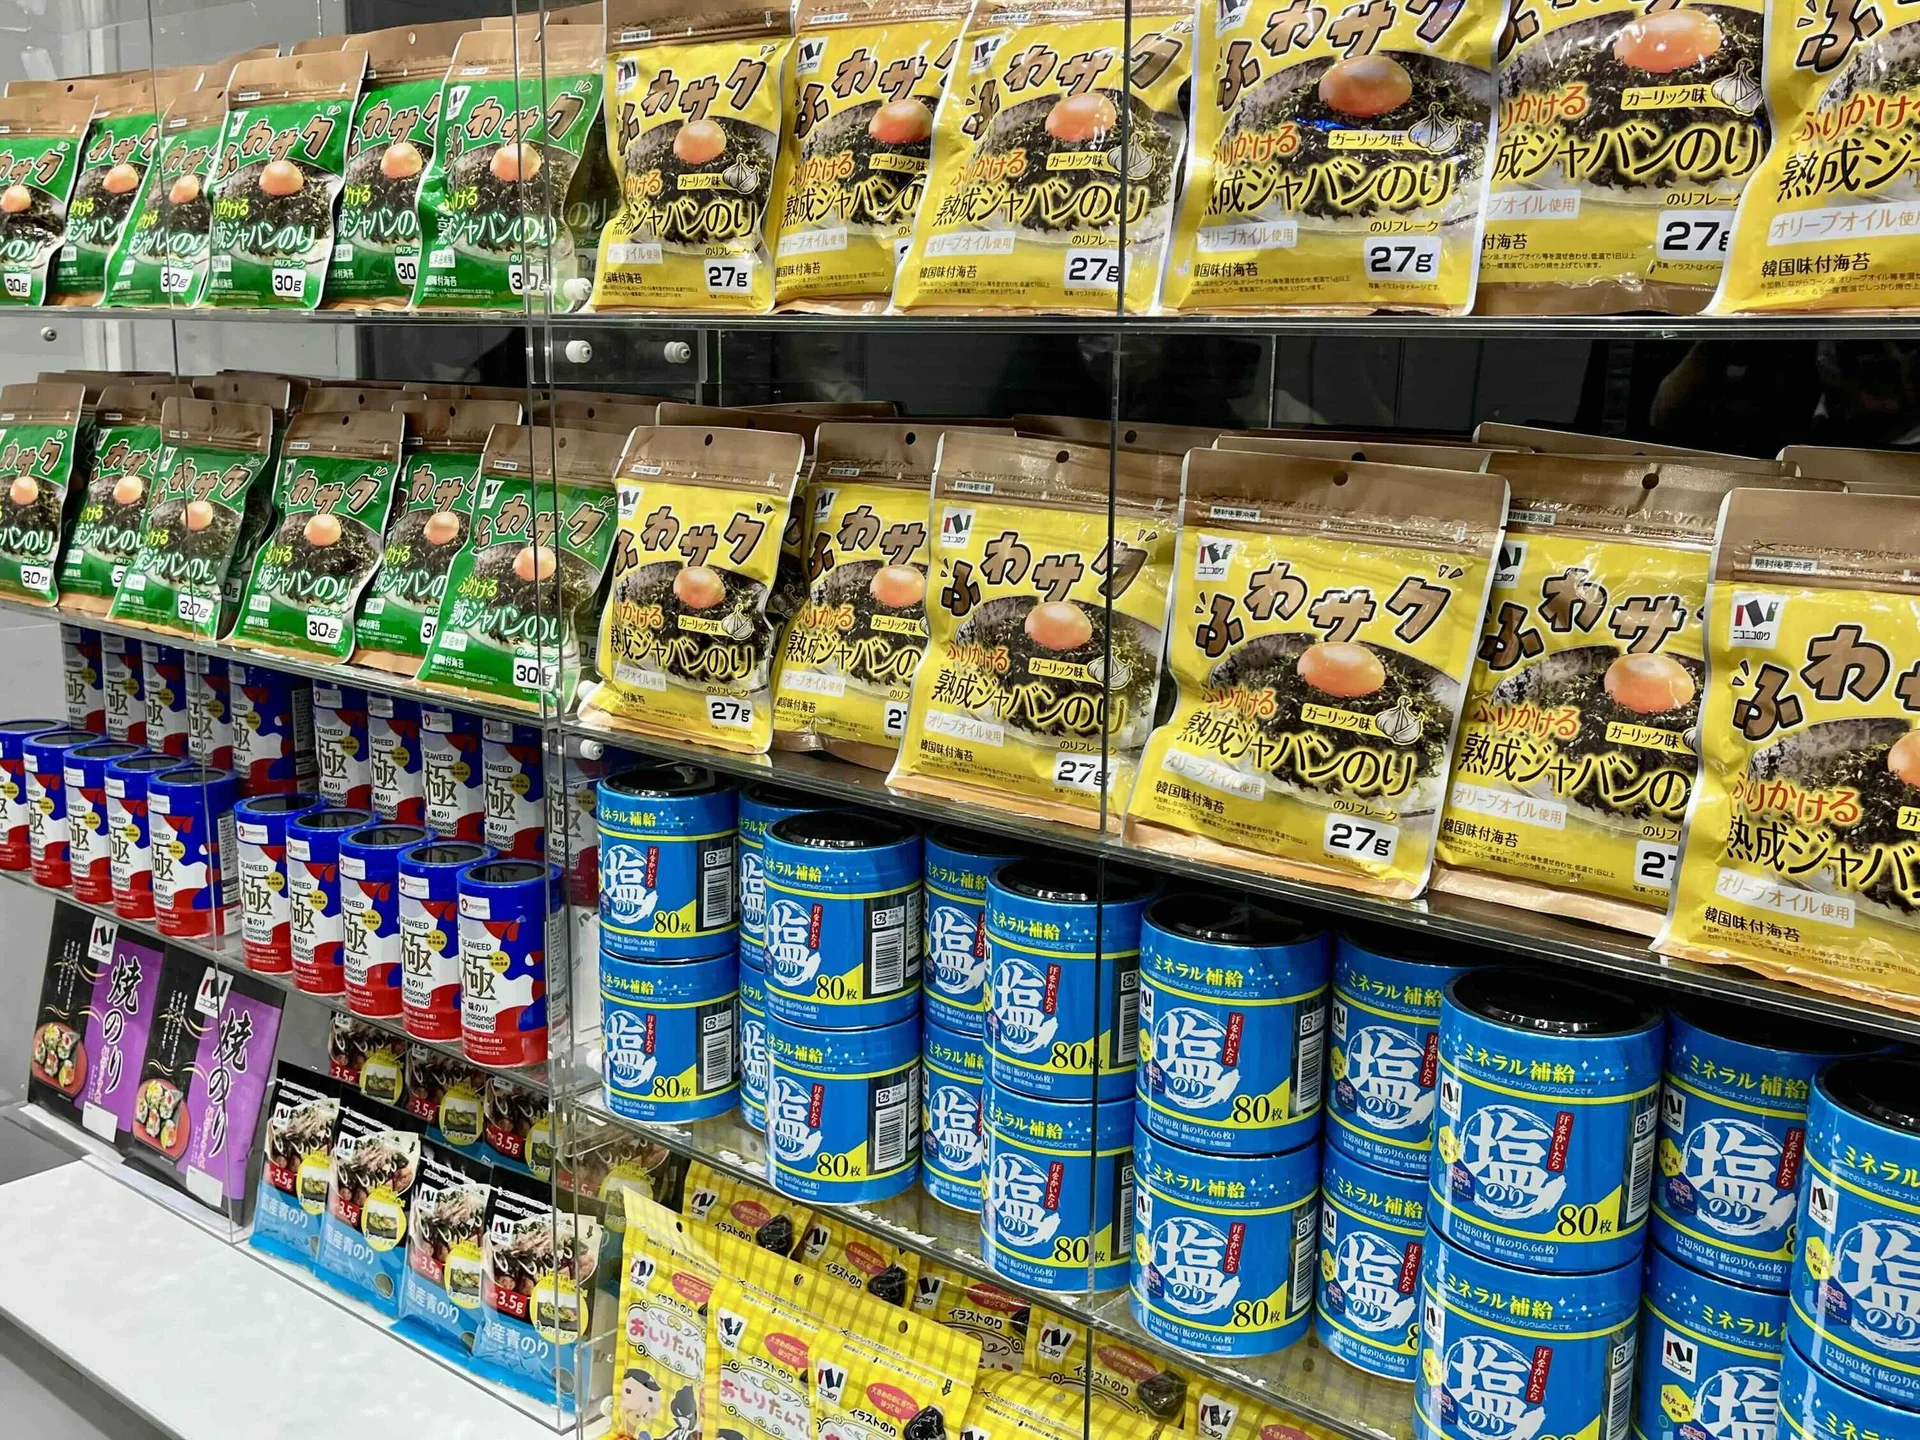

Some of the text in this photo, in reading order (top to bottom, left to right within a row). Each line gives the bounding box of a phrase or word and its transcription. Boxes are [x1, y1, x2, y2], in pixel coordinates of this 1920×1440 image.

[961, 33, 1183, 140] ふわサク
[1626, 89, 1708, 106] ガーリック味
[617, 58, 766, 156] ふわサク
[1331, 133, 1405, 147] ガーリック味
[1049, 154, 1103, 168] ガーリック味
[679, 175, 721, 188] ガーリック味
[932, 183, 1147, 228] 熟成ジャバンのり
[1370, 221, 1439, 233] のりフレーク
[1482, 234, 1528, 250] 付海苔
[919, 265, 977, 280] 韓国味付海苔
[1068, 257, 1120, 282] 27g
[1371, 246, 1434, 273] 27g
[1760, 252, 1870, 277] 韓国味付海苔
[6, 278, 28, 293] 30g
[274, 278, 303, 293] 30g
[708, 266, 748, 287] 27g
[616, 506, 765, 577] ふわサク
[22, 571, 48, 586] 30g
[944, 532, 1147, 616] ふわサク
[180, 602, 209, 617] 30g
[1195, 562, 1451, 656] ふわサク
[309, 621, 338, 638] 30g
[680, 618, 719, 632] ガーリック味
[873, 617, 917, 633] ガーリック味
[1734, 629, 1771, 641] ニコニコのり
[515, 665, 552, 685] 30g
[1031, 660, 1085, 679] ガーリック味
[711, 701, 751, 722] 27g
[932, 668, 1124, 735] 熟成ジャバンのり
[1305, 706, 1372, 731] ガーリック味
[1473, 703, 1577, 738] ふりかける
[1608, 725, 1679, 749] ガーリック味
[318, 740, 348, 779] 極
[424, 751, 454, 763] SEAWEED
[920, 740, 974, 763] 韓国味付海苔
[1177, 711, 1413, 797] 熟成ジャバンのり
[372, 750, 399, 791] 極
[1057, 762, 1110, 785] 27g
[1457, 731, 1692, 812] 熟成ジャバンの
[425, 763, 457, 807] 極
[484, 775, 517, 820] 極
[1156, 780, 1225, 816] 韓国味付海苔
[1733, 771, 1860, 823] ふりかける
[431, 807, 450, 820] 味のり
[1333, 800, 1398, 820] のりフレーク
[488, 821, 507, 834] 味のり
[1330, 824, 1390, 857] 27g
[1442, 817, 1518, 848] 韓国味付海苔
[605, 851, 652, 904] 塩
[241, 875, 272, 916] 極
[615, 900, 635, 916] のり
[290, 892, 315, 935] 極
[654, 911, 692, 934] 80枚
[992, 910, 1061, 941] ミネラル補給
[1704, 906, 1800, 944] 韓国味付海苔
[343, 912, 367, 955] 極
[767, 909, 816, 962] 塩
[402, 933, 432, 977] 極
[778, 959, 798, 978] のり
[406, 977, 424, 989] 味のり
[463, 953, 498, 1001] 極
[1153, 952, 1245, 989] ミネラル補給
[816, 975, 857, 1001] 80枚
[994, 968, 1054, 1026] 塩
[1047, 964, 1060, 1013] 汗をかいたら
[1349, 972, 1442, 1009] ミネラル補給
[468, 1002, 489, 1014] 味のり
[102, 953, 143, 1094] 焼のり
[1006, 1023, 1030, 1043] のり
[605, 1018, 652, 1069] 塩
[1154, 1016, 1237, 1090] 塩
[1224, 1015, 1242, 1064] 汗をかいたら
[615, 1064, 635, 1080] のり
[1348, 1031, 1430, 1106] 塩
[1423, 1033, 1438, 1087] 汗をかいたら
[1464, 1043, 1576, 1085] ミネラル補給
[205, 1007, 254, 1158] 焼のり
[654, 1077, 692, 1099] 80枚
[1172, 1077, 1205, 1098] のり
[1689, 1056, 1808, 1099] ミネラル補給
[412, 1098, 435, 1122] 3.5g
[1232, 1096, 1283, 1124] 80枚
[1365, 1096, 1401, 1120] のり
[496, 1130, 520, 1156] 3.5g
[778, 1135, 798, 1152] のり
[1464, 1115, 1561, 1195] 塩
[1550, 1114, 1571, 1170] 汗をかいたら
[817, 1153, 862, 1178] 80枚
[1687, 1127, 1789, 1206] 塩
[1779, 1130, 1802, 1187] 汗をかいたら
[273, 1169, 293, 1188] 3.5g
[1049, 1164, 1063, 1211] 汗をかいたら
[1153, 1162, 1247, 1199] ミネラル補給
[1336, 1176, 1424, 1220] ミネラル補給
[1485, 1183, 1525, 1205] のり
[338, 1199, 359, 1224] 3.5g
[1557, 1205, 1612, 1237] 80枚
[1709, 1197, 1752, 1224] のり
[715, 1221, 753, 1243] イラストのり
[1224, 1224, 1243, 1273] 汗をかいたら
[420, 1257, 442, 1282] 3.5g
[825, 1261, 864, 1289] イラストのり
[1403, 1242, 1419, 1293] 汗をかいたら
[496, 1288, 525, 1314] 3.5g
[655, 1292, 694, 1318] イラストのり
[1172, 1282, 1205, 1304] のり
[1447, 1274, 1553, 1319] ミネラル補給
[948, 1308, 1004, 1330] イラストのり
[1233, 1299, 1281, 1329] 80枚
[1867, 1304, 1917, 1336] のり
[748, 1355, 795, 1384] イラストのり
[1074, 1365, 1131, 1397] イラストのり
[1451, 1343, 1541, 1422] 塩
[1531, 1348, 1549, 1402] 汗をかいたら
[849, 1408, 897, 1437] イラストのり
[1468, 1409, 1506, 1433] のり
